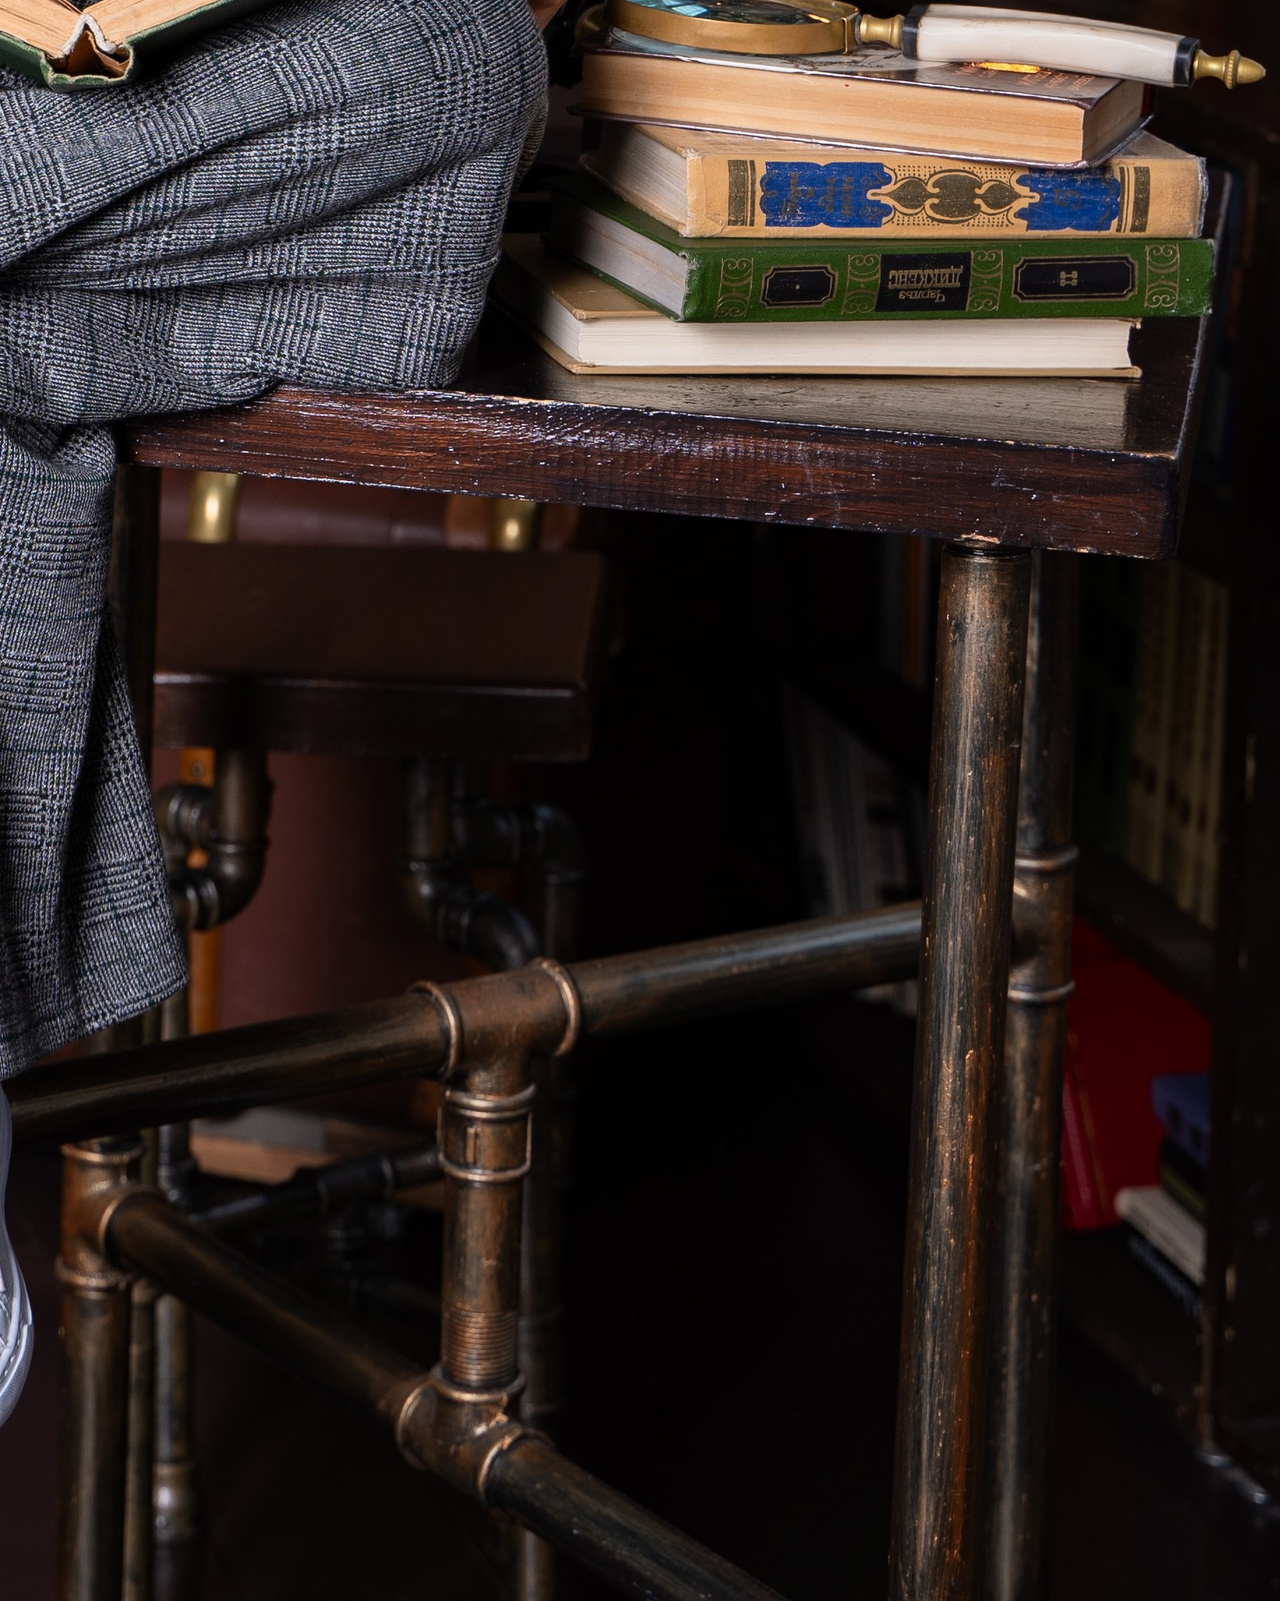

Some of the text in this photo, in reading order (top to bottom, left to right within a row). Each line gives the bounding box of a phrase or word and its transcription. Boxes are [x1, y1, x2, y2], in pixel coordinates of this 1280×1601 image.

[1054, 189, 1081, 210] 5
[888, 265, 964, 290] ДИККЕНС
[898, 289, 946, 303] Чарльз
